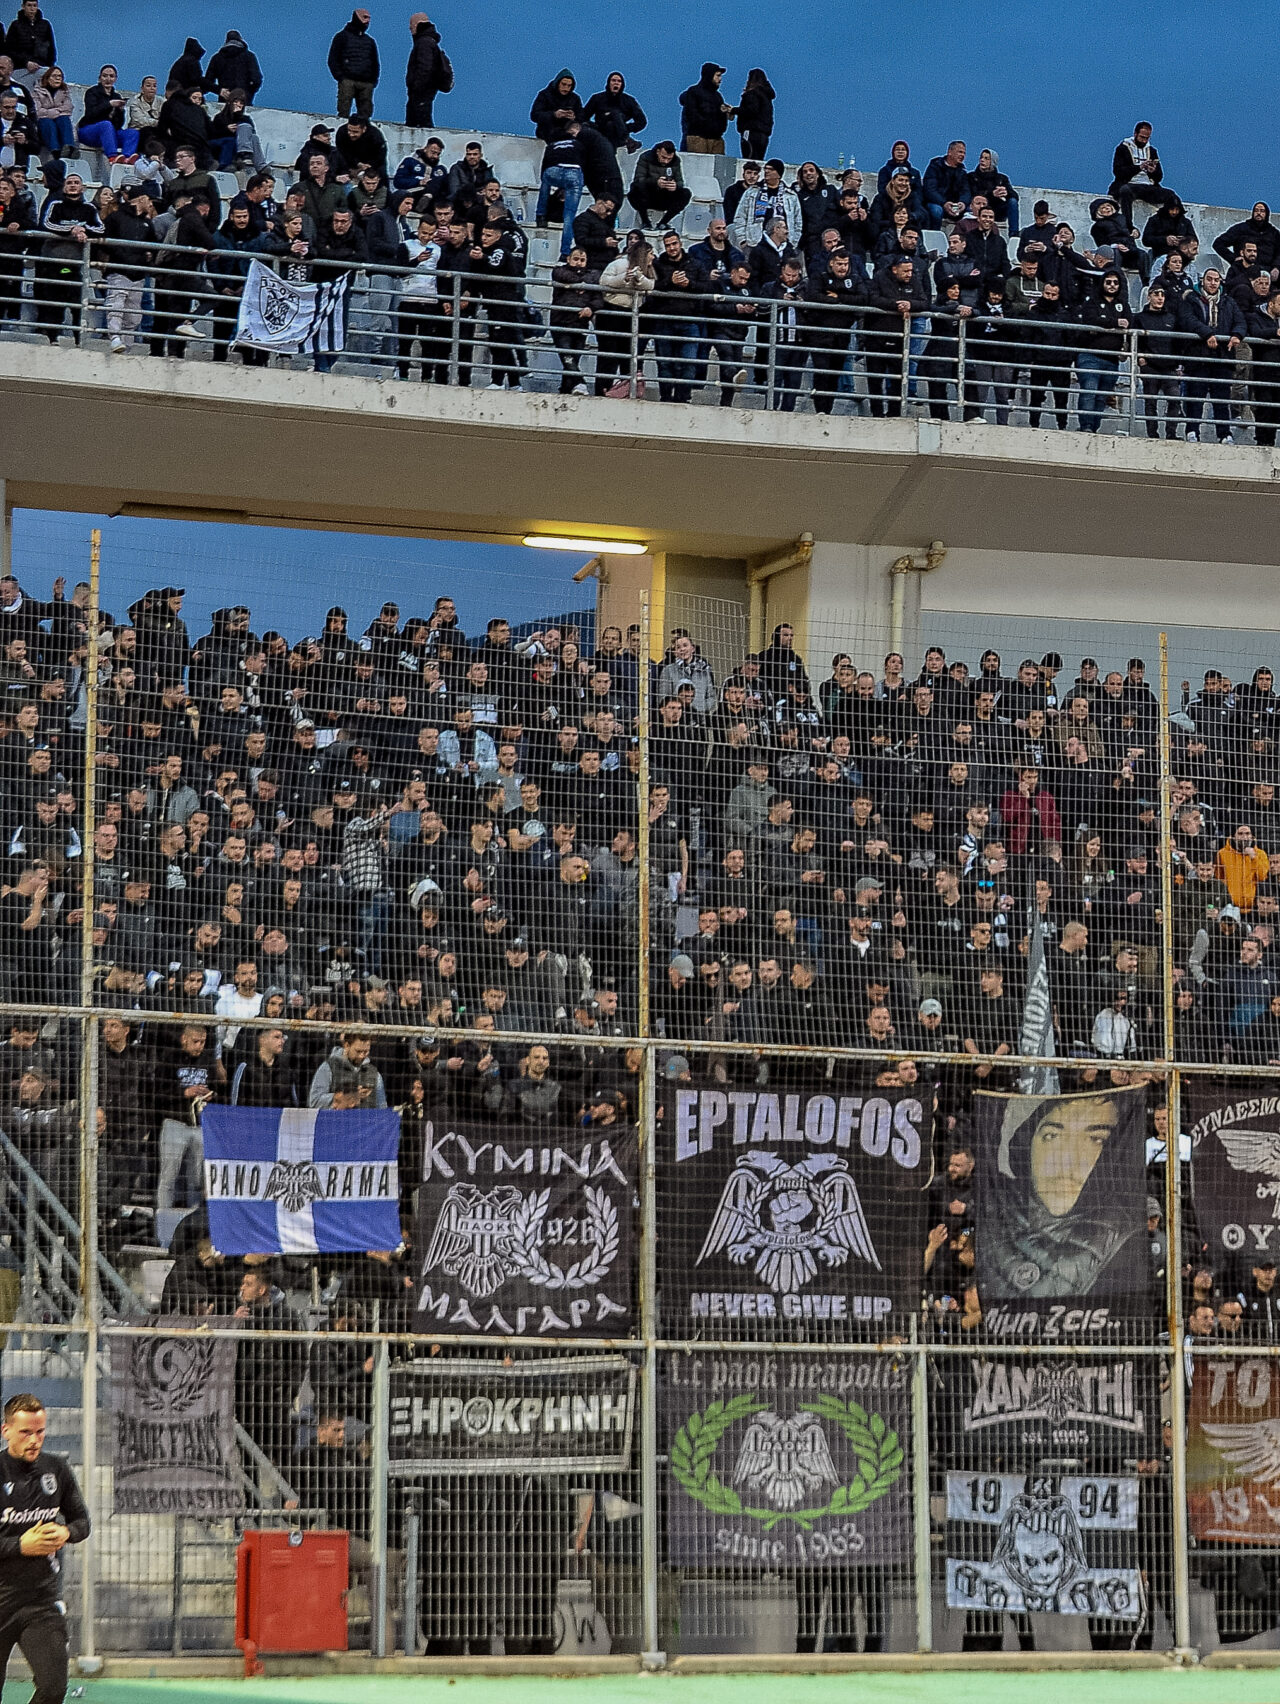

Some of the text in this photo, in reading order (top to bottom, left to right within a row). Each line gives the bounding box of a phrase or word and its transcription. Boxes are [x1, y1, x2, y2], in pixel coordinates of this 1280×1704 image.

[676, 1090, 922, 1169] EPTALOFOS
[460, 1220, 505, 1232] ΠΑΟΚ
[535, 1217, 597, 1246] 1926
[417, 1285, 627, 1335] ΜΑΛΓΑΡΑ
[691, 1292, 892, 1321] NEVER GIVE UP
[967, 1476, 1119, 1519] 19 94
